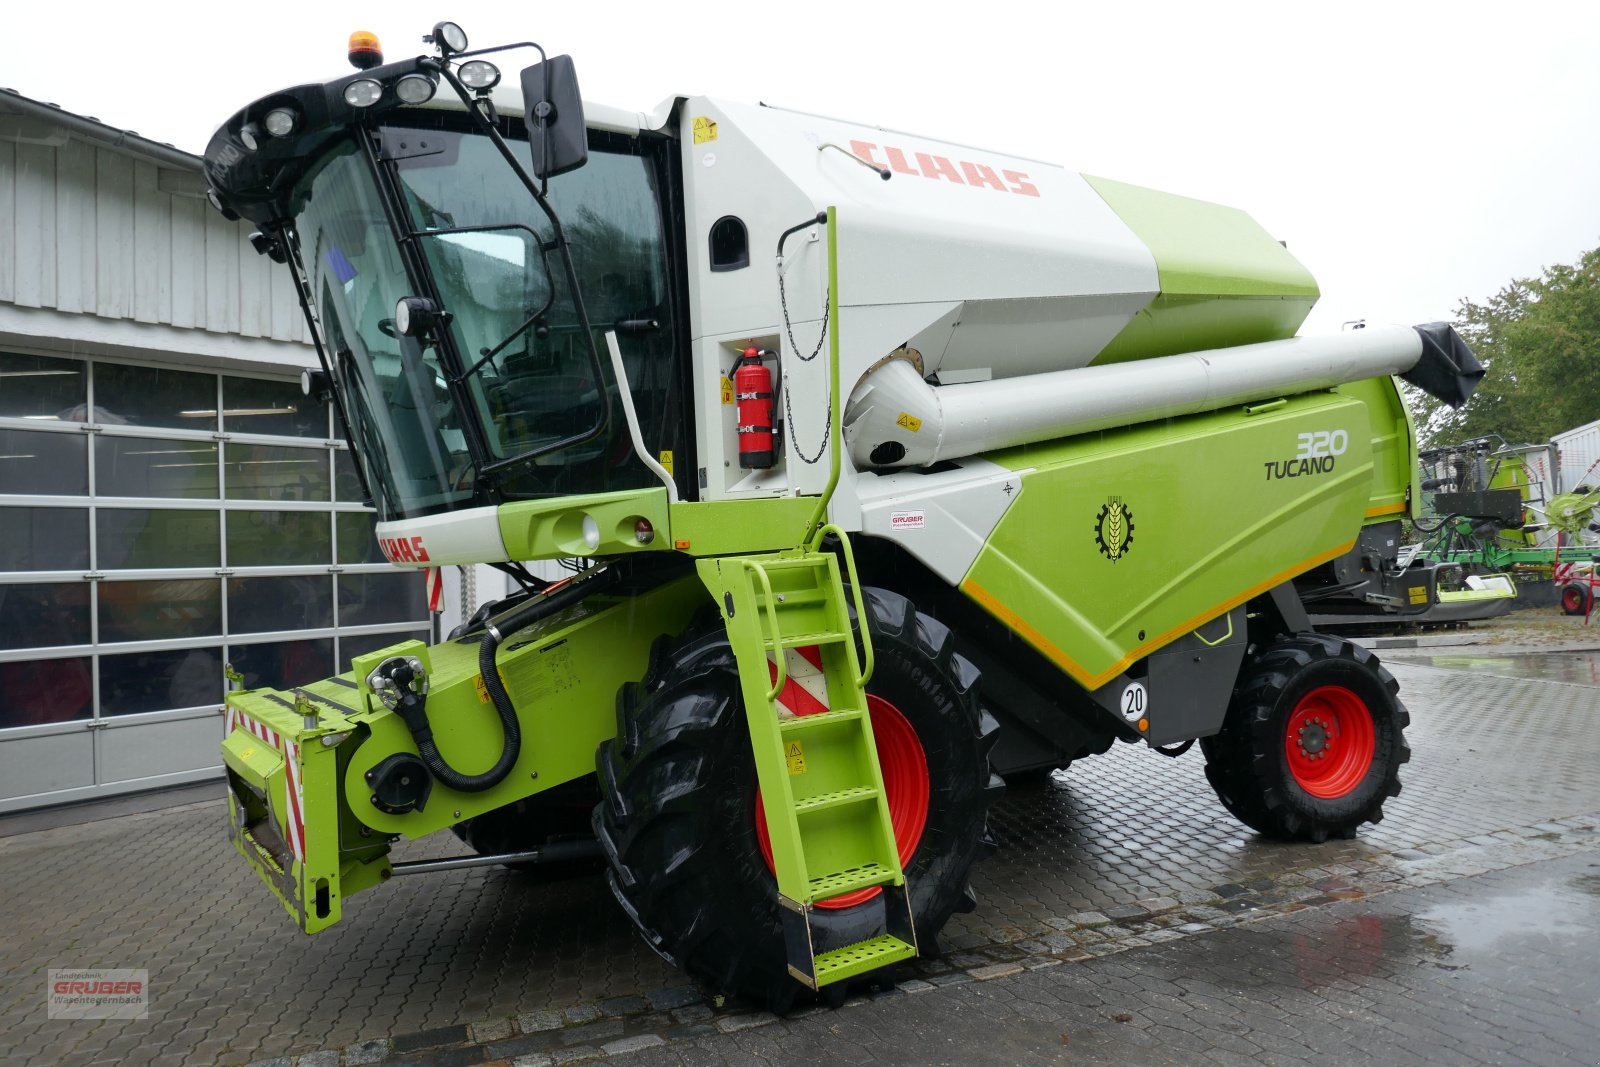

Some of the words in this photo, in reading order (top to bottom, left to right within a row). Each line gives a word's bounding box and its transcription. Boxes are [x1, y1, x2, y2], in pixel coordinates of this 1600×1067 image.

[849, 139, 1041, 198] CLAAS
[1296, 429, 1348, 459] 320
[1264, 455, 1335, 481] TUCANO
[892, 515, 924, 523] GRUBER
[380, 536, 431, 563] LAAS
[1126, 687, 1143, 714] 20
